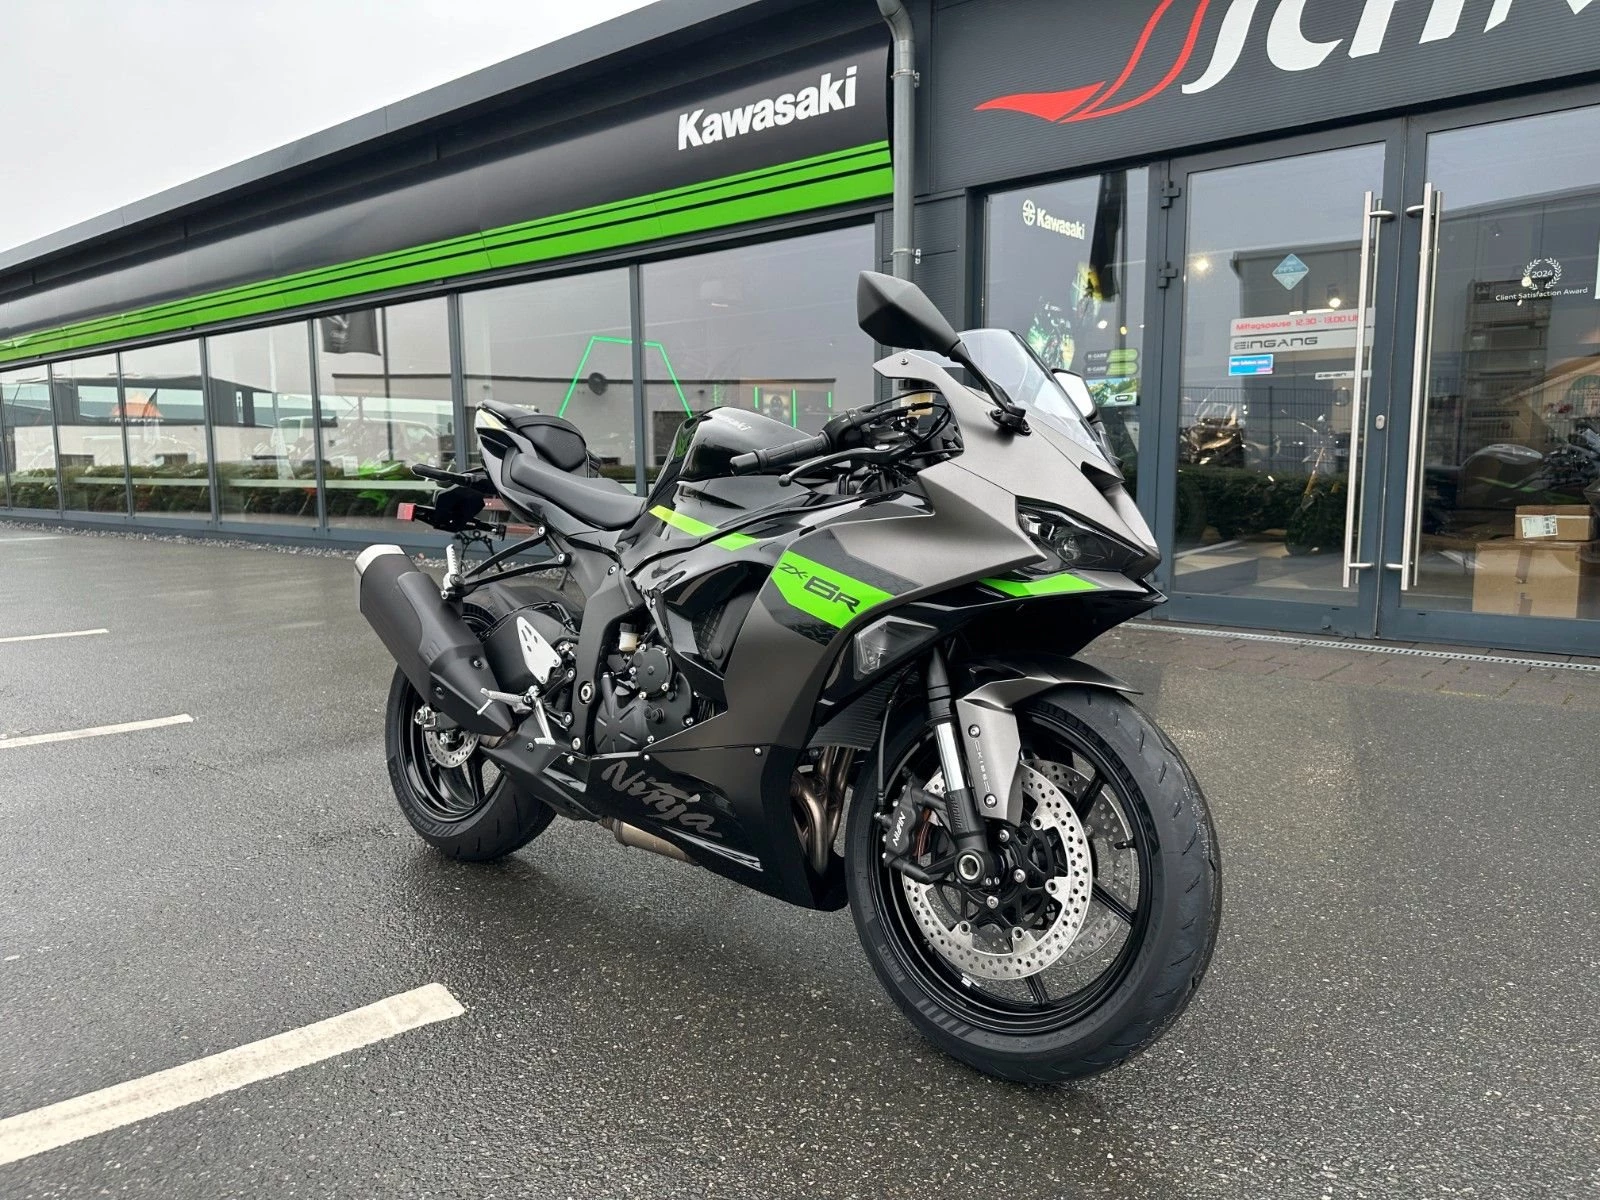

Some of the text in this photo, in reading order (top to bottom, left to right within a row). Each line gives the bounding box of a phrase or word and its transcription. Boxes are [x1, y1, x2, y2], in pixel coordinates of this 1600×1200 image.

[678, 65, 857, 150] Kawasaki
[1036, 208, 1085, 240] Kawasaki
[1531, 270, 1554, 279] 2024
[1495, 287, 1588, 301] Client Satisfaction Award
[1236, 321, 1291, 330] Mittagspause
[601, 760, 723, 838] Ninja
